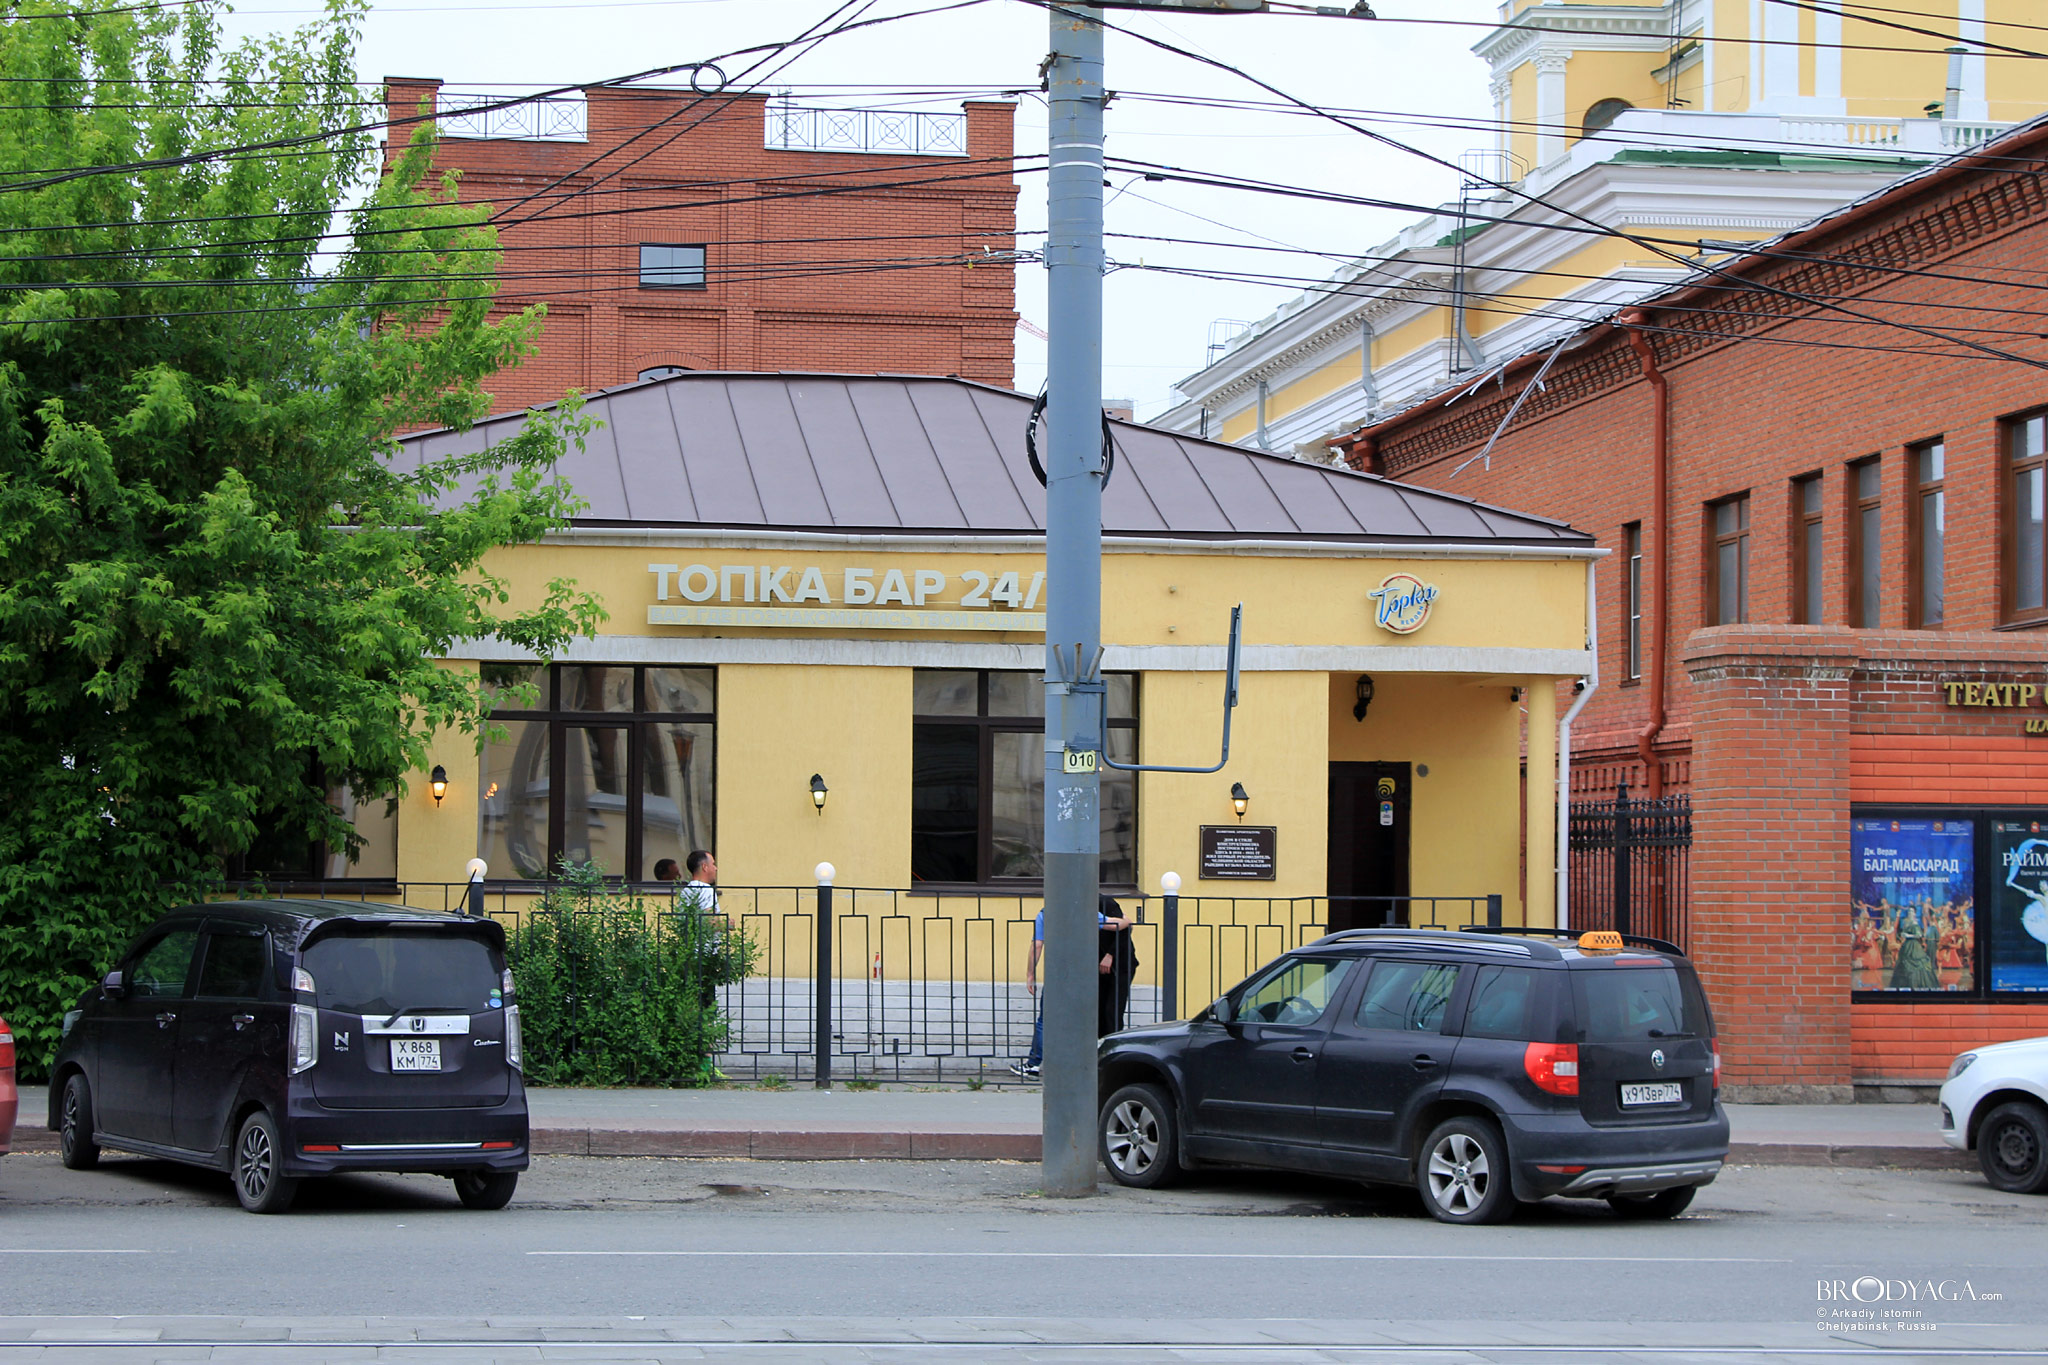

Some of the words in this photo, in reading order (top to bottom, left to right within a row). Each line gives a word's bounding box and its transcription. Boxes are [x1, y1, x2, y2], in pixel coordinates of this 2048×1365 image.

[647, 563, 831, 604] ТОПКА
[844, 568, 946, 606] БАР
[960, 570, 1046, 609] 24/
[651, 608, 692, 624] БАР,
[697, 609, 732, 624] ГДЕ
[736, 609, 912, 627] ПОЗНАКОМИЛИСЬ
[917, 612, 968, 627] ТВОИ
[973, 613, 1046, 629] РОДИТЕ
[1943, 682, 2037, 707] ТЕАТР
[1069, 754, 1094, 767] 010
[1876, 847, 1898, 856] Верди
[1863, 859, 1959, 874] БАЛ-МАСКАРАД
[334, 1032, 350, 1046] N
[411, 1042, 433, 1053] 868
[397, 1057, 416, 1068] КМ
[421, 1056, 438, 1066] 774
[1664, 1084, 1680, 1097] 774
